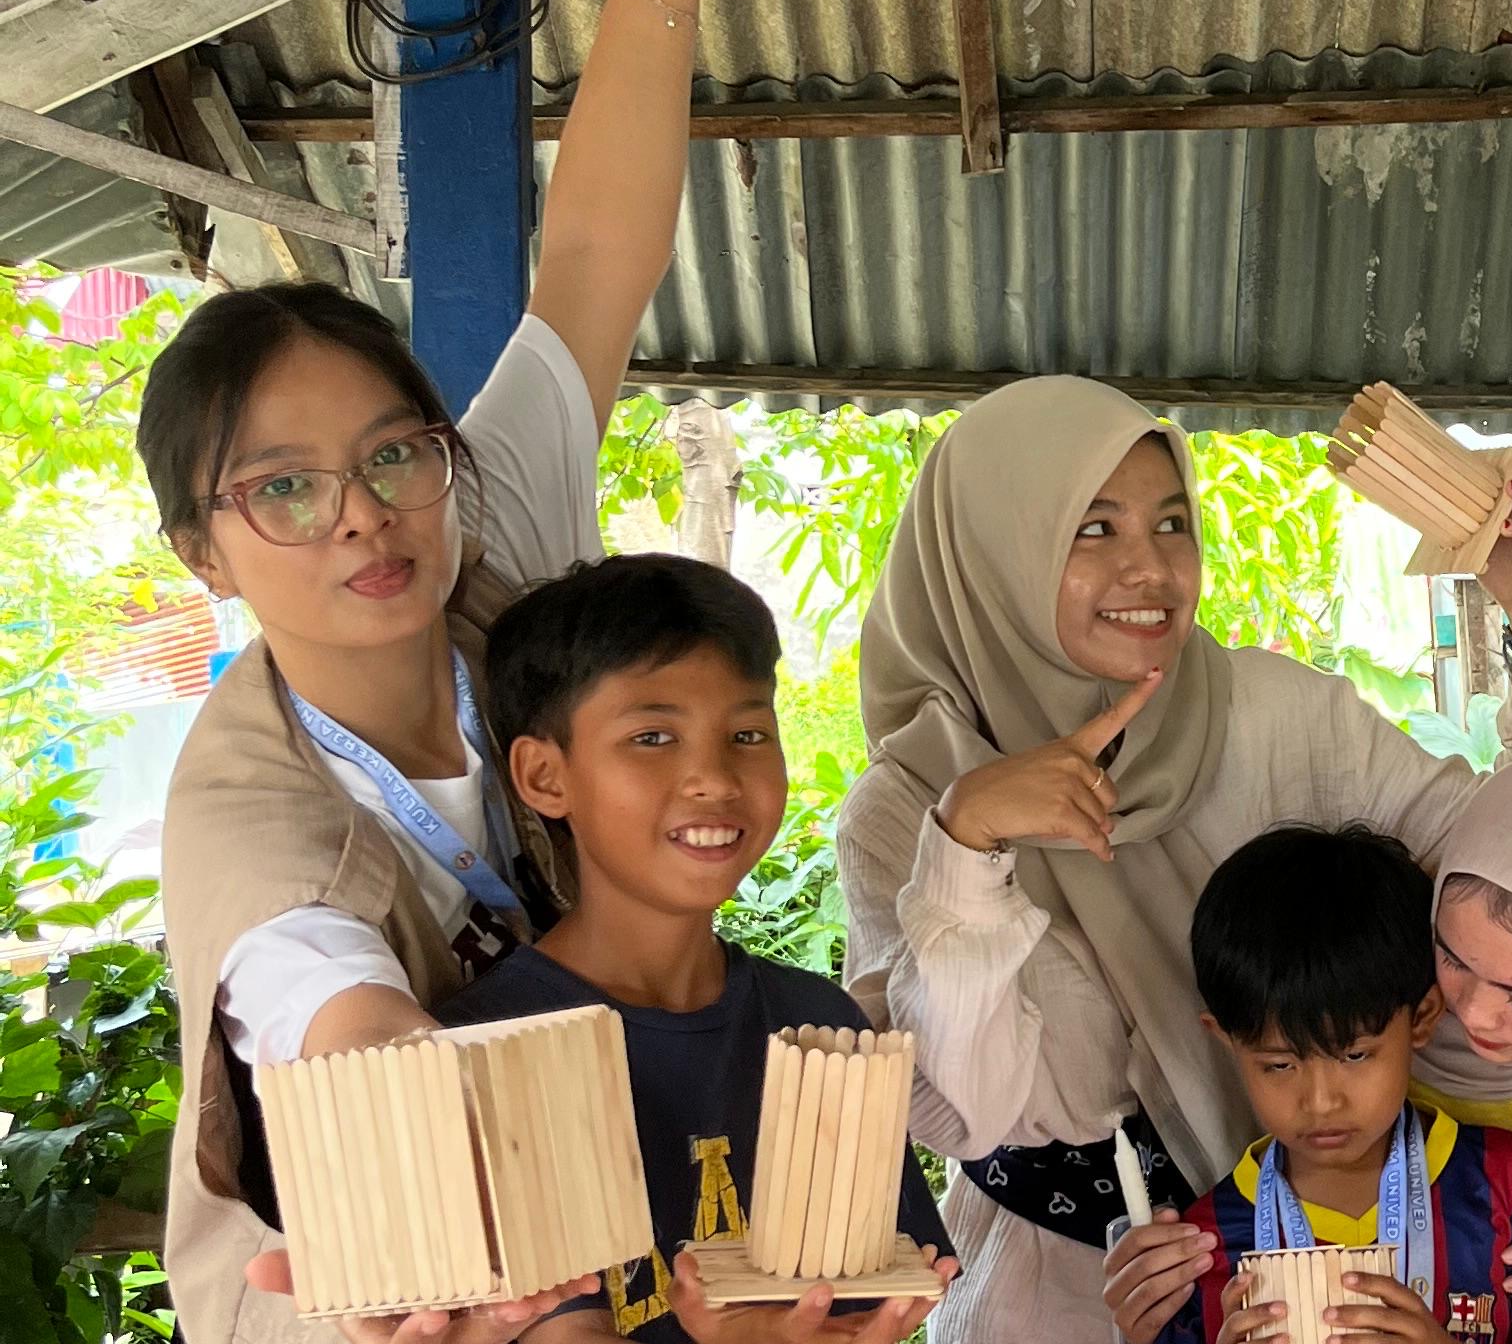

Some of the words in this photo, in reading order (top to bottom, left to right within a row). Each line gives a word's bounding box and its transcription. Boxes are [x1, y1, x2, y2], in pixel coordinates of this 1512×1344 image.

[382, 766, 442, 836] KULIAH
[1260, 1207, 1275, 1251] LIAH
[1385, 1170, 1401, 1240] UNIVED
[1408, 1162, 1428, 1232] UNIVED
